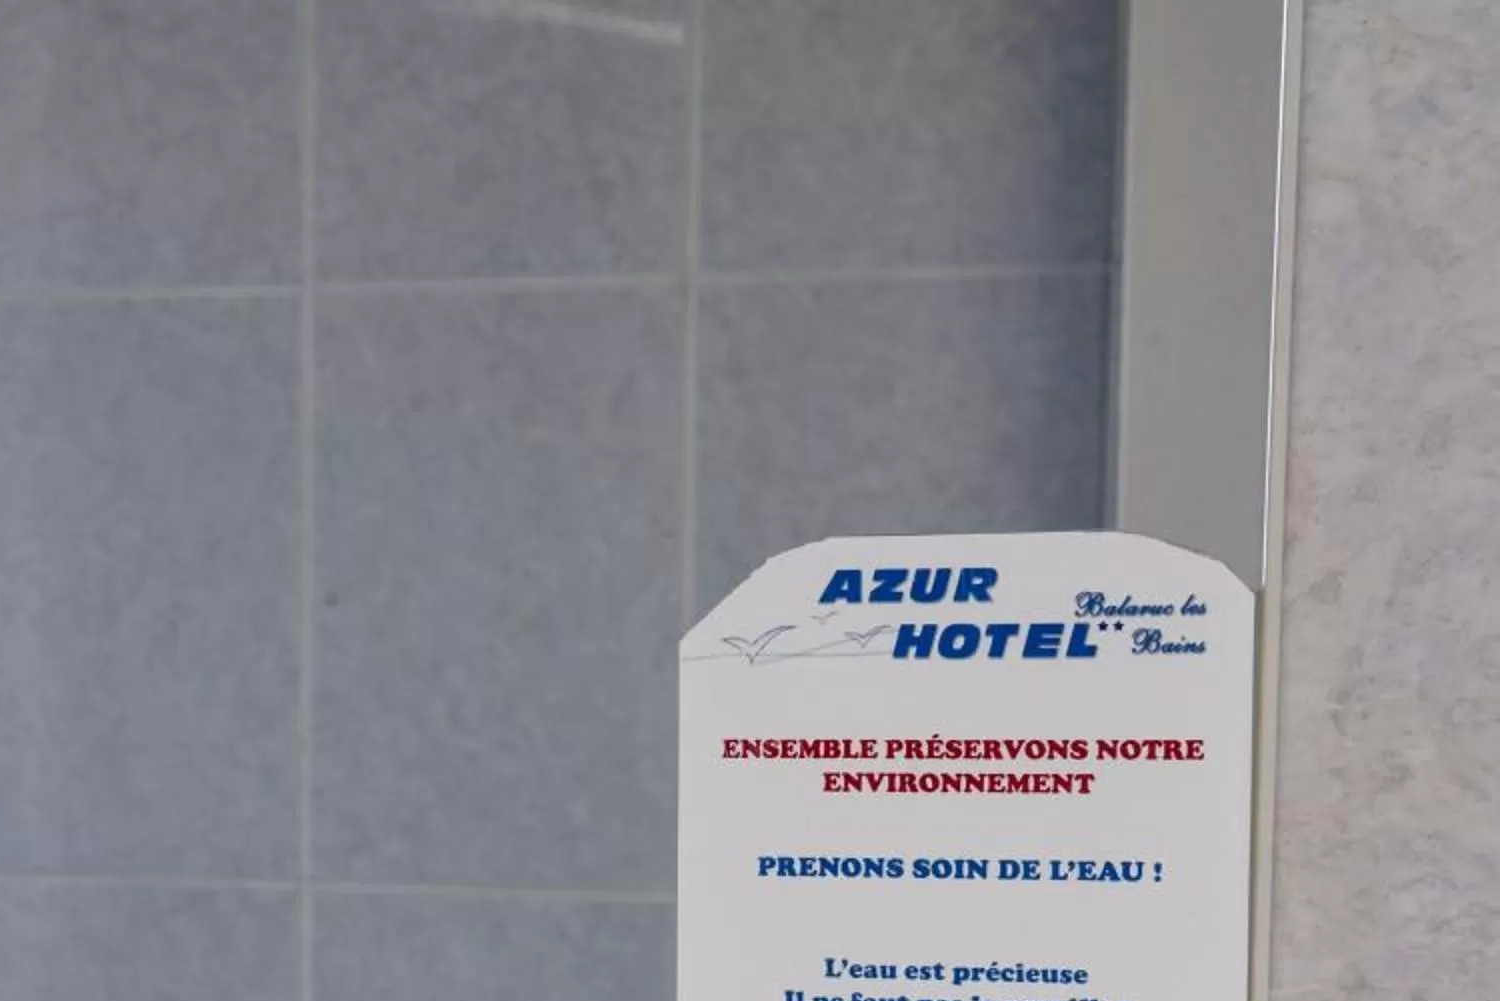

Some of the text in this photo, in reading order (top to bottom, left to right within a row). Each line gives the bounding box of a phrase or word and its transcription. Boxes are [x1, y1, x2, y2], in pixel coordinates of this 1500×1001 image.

[818, 567, 999, 605] AZUR
[1074, 591, 1207, 618] Balaruc les
[892, 622, 1099, 660] HOTEL
[1131, 627, 1207, 655] Bains
[722, 733, 1205, 761] ENSEMBLE PRÉSERVONS NOTRE
[822, 771, 1096, 795] ENVIRONNEMENT
[757, 856, 905, 879] PRENONS
[911, 858, 988, 880] SOIN
[997, 859, 1041, 881] DE
[1049, 859, 1145, 883] L'EAU
[824, 957, 1089, 986] L'eau est précieuse
